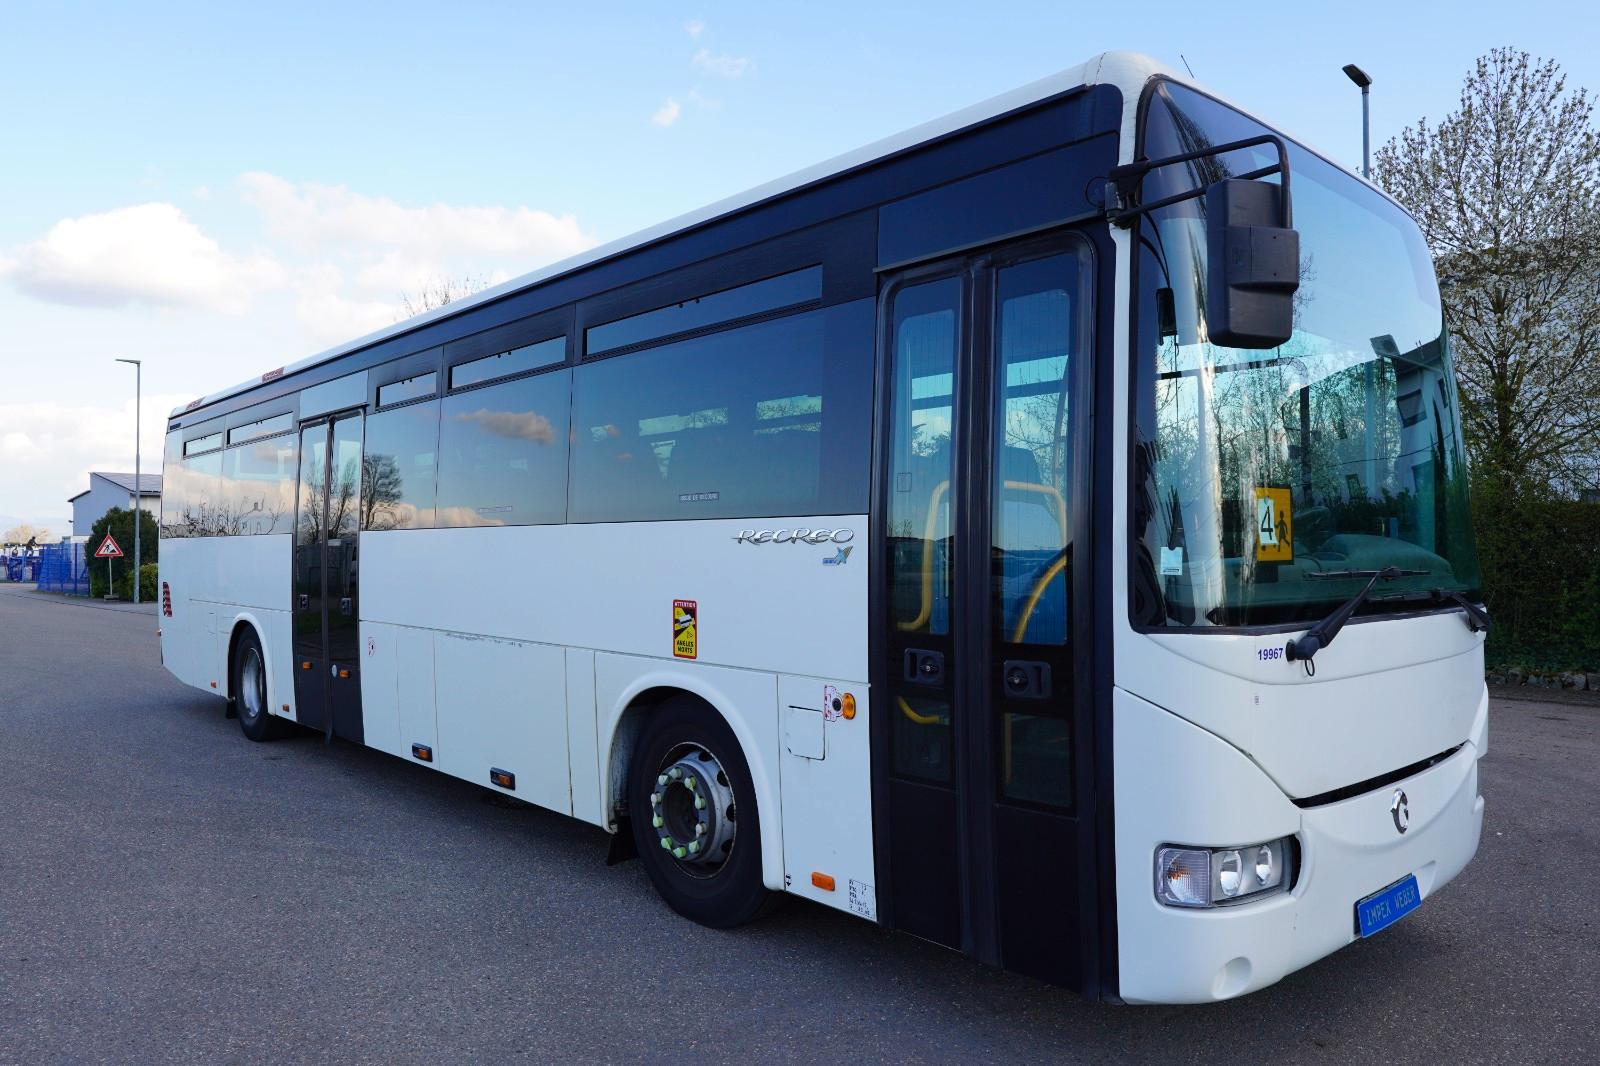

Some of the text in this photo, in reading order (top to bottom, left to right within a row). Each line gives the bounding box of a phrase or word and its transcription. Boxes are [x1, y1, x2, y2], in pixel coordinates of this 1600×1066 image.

[1261, 505, 1273, 541] 4
[732, 528, 854, 545] RECREO
[677, 646, 693, 654] MORTS
[1258, 647, 1284, 661] 19967
[1366, 885, 1416, 927] IMPEX WEBER
